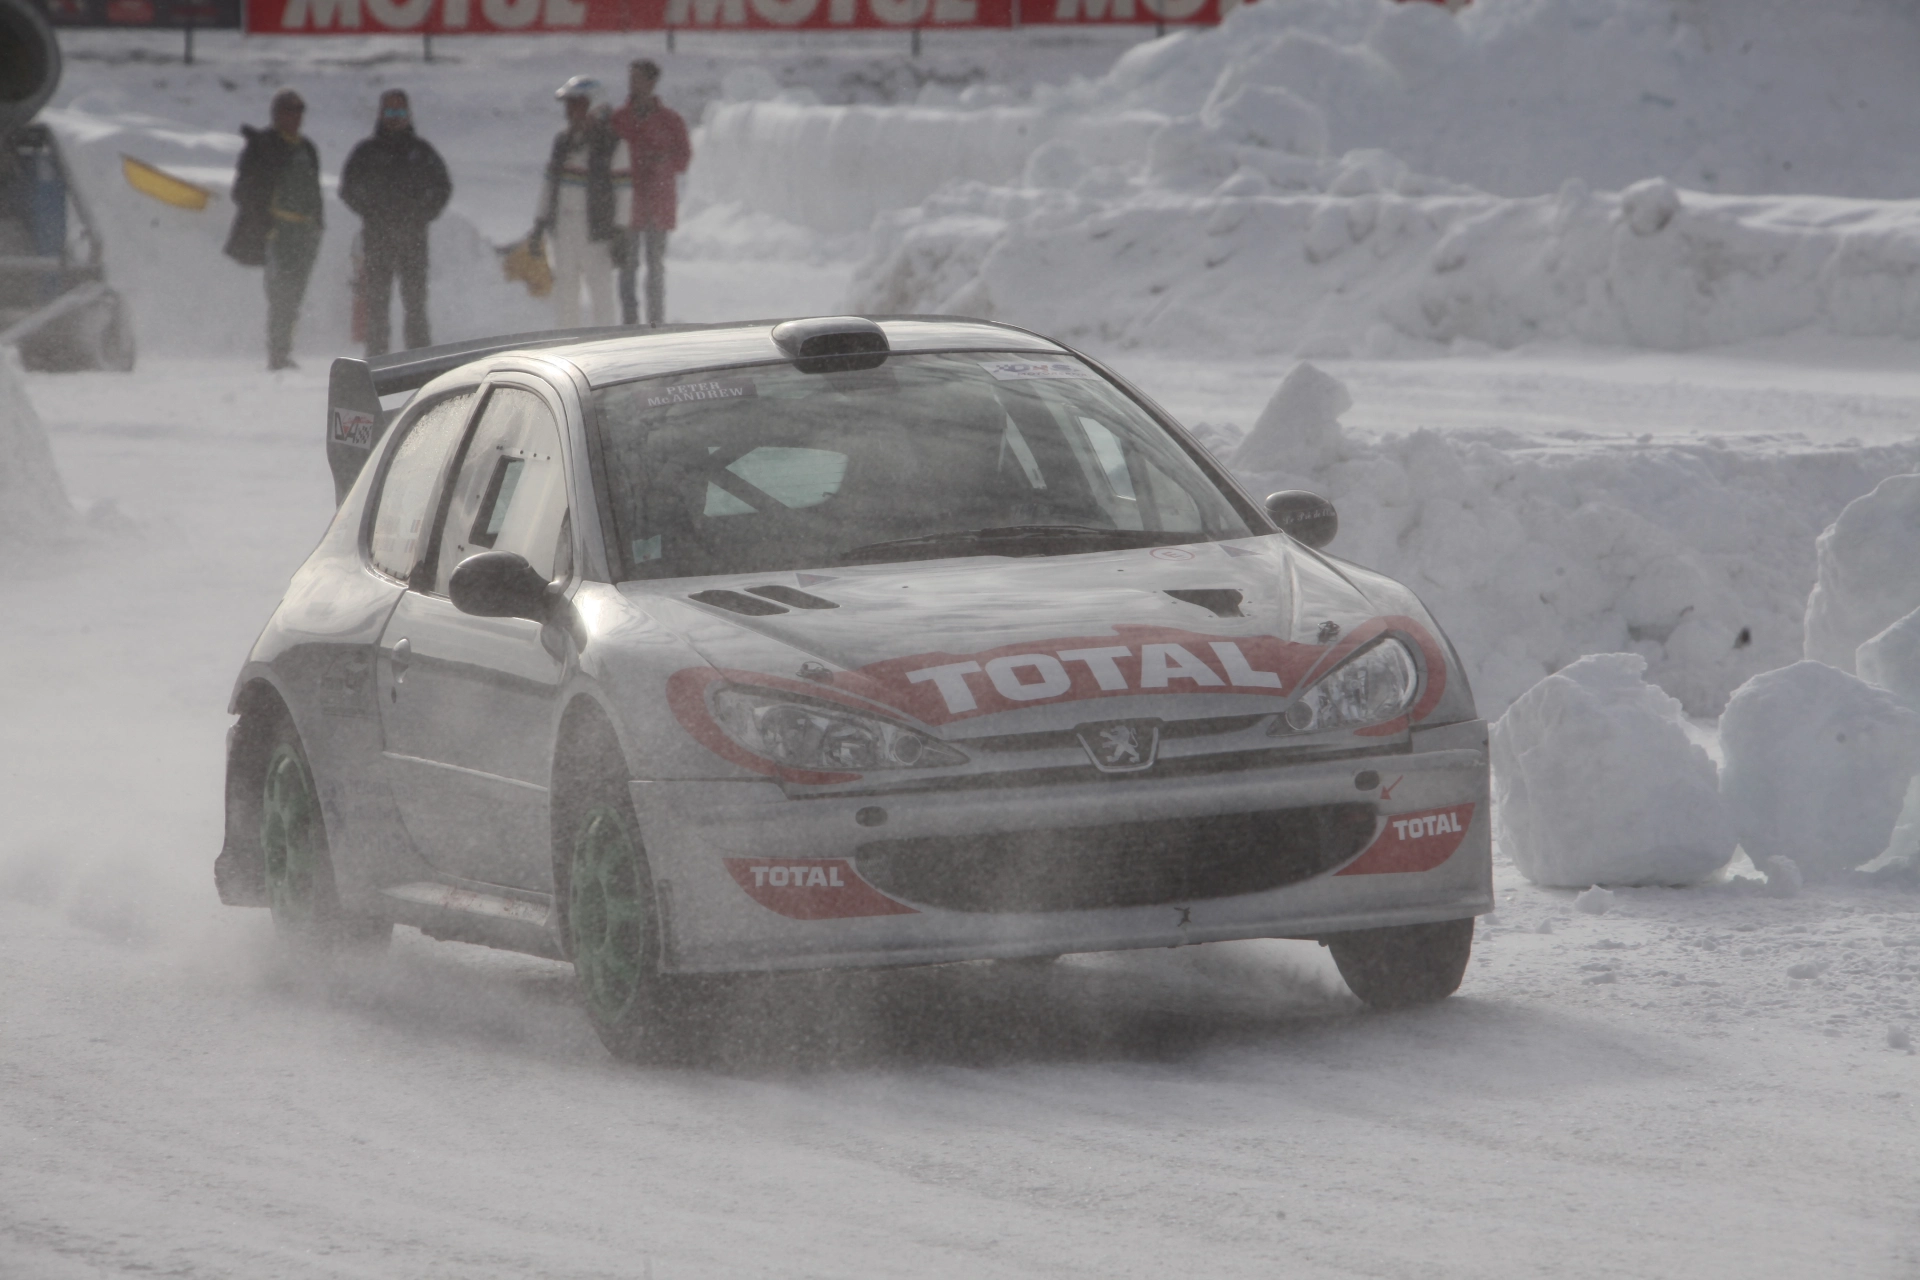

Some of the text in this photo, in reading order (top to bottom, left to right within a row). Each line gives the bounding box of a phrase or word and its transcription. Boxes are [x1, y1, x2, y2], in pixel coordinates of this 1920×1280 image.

[666, 381, 720, 395] PETER
[905, 641, 1282, 714] TOTAL
[1392, 812, 1462, 841] TOTAL
[750, 866, 844, 887] TOTAL
